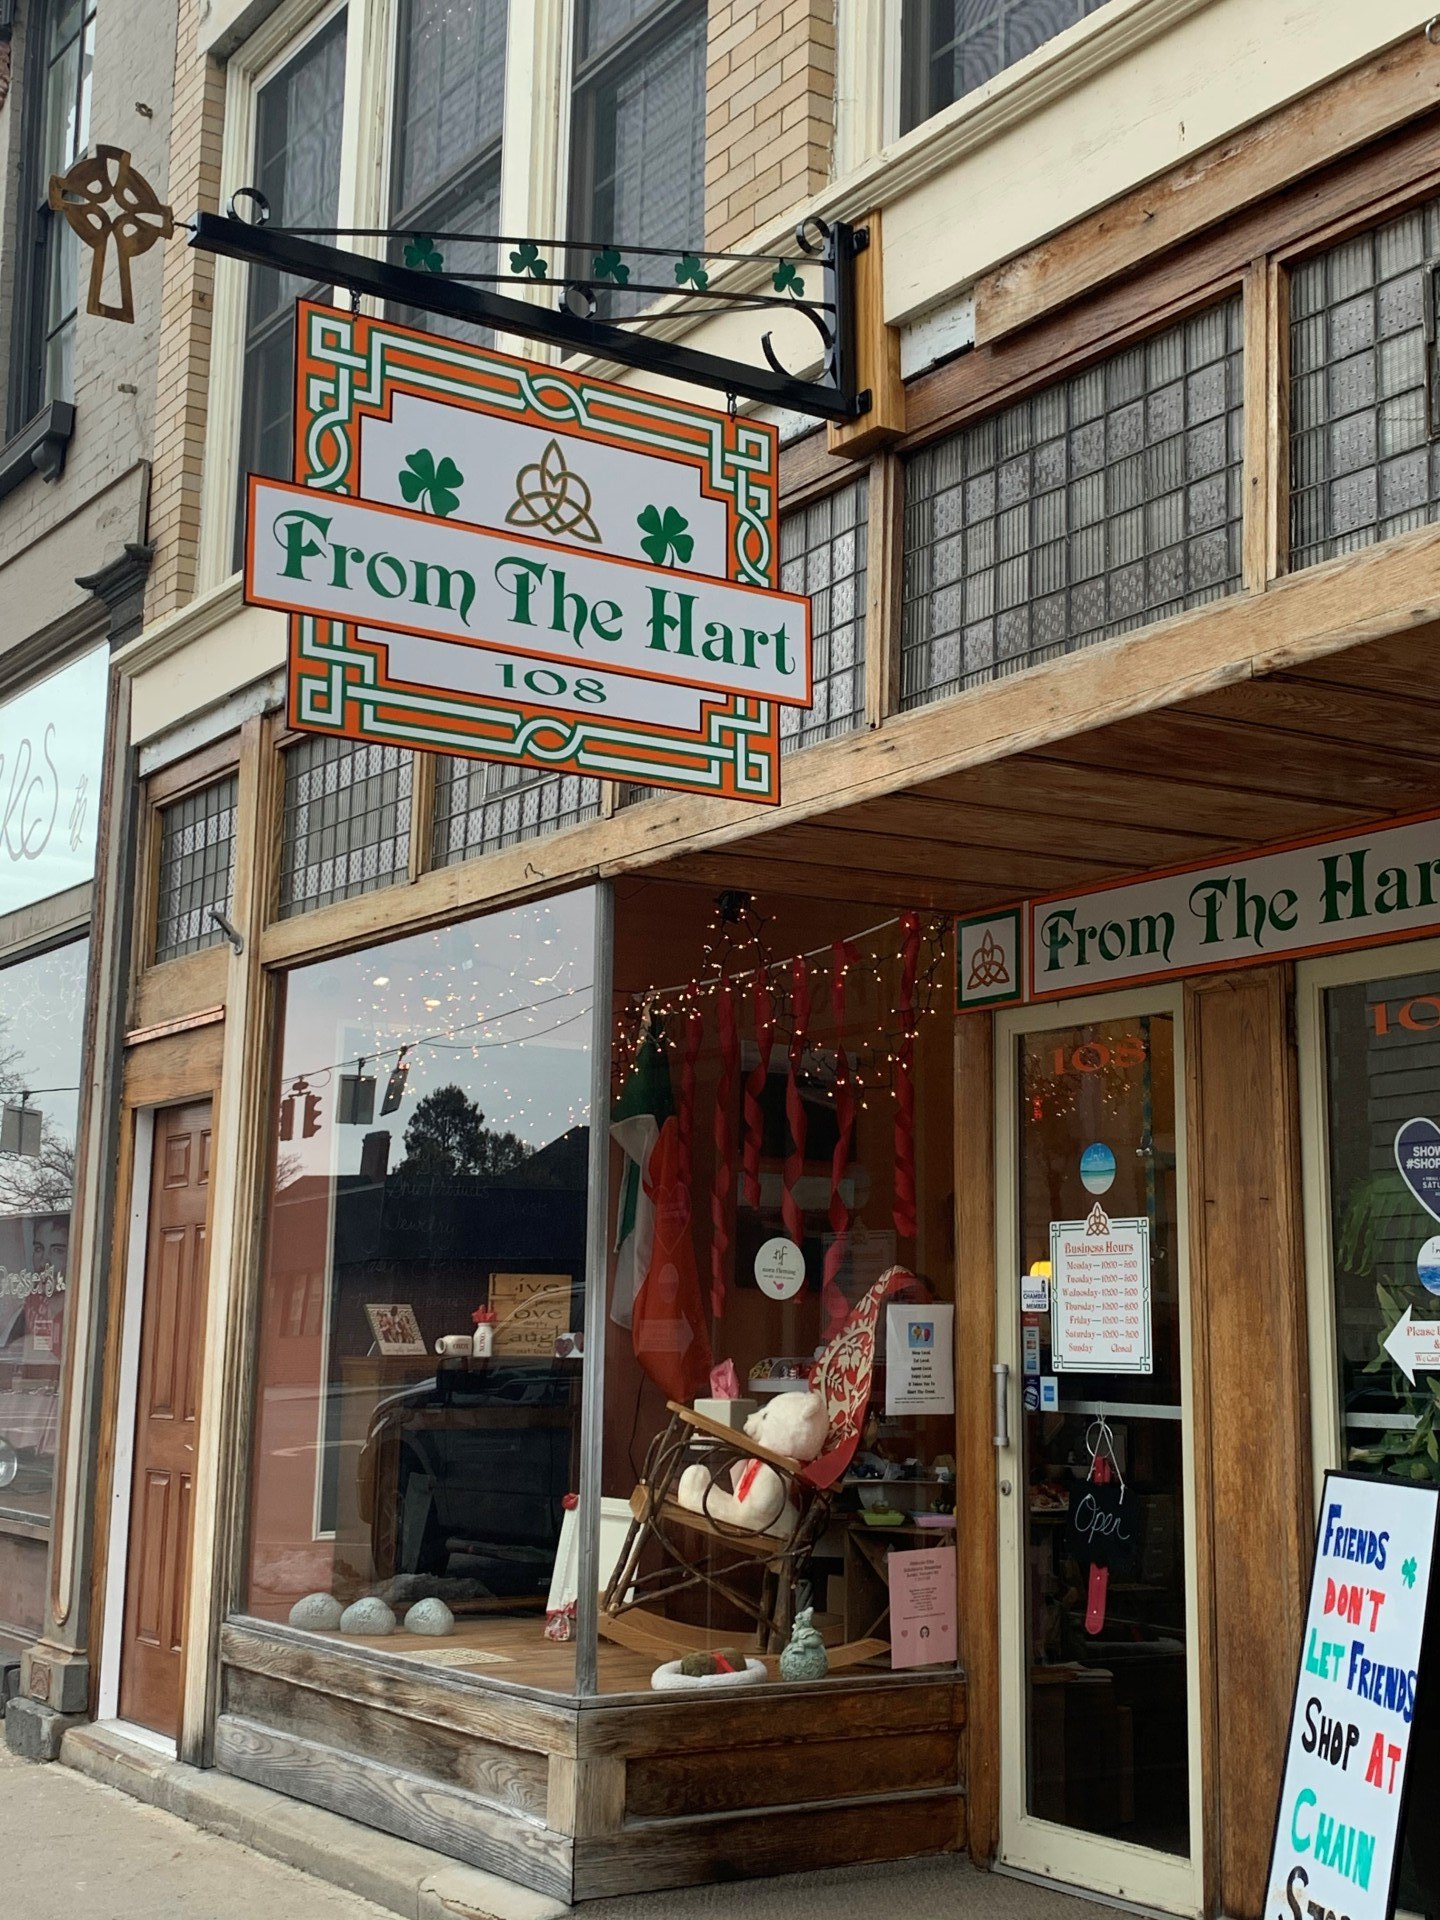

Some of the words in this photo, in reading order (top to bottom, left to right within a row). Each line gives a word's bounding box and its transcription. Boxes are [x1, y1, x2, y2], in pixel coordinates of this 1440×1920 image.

[273, 510, 476, 627] From
[494, 556, 623, 649] The
[644, 585, 796, 675] Hart
[495, 663, 607, 703] 108
[1041, 907, 1175, 972] From
[1188, 874, 1299, 948] The
[1053, 1036, 1146, 1075] 108
[1065, 1242, 1103, 1255] Business
[1105, 1241, 1134, 1253] Hours
[1068, 1343, 1093, 1353] Sunday
[1110, 1343, 1132, 1353] Closed
[1406, 1326, 1435, 1336] Please
[1075, 1493, 1131, 1543] Open
[1323, 1577, 1386, 1633] DON'T
[1305, 1627, 1345, 1682] LET
[1301, 1697, 1360, 1771] SHOP
[1364, 1732, 1402, 1794] AT
[1291, 1788, 1376, 1893] CHAIN
